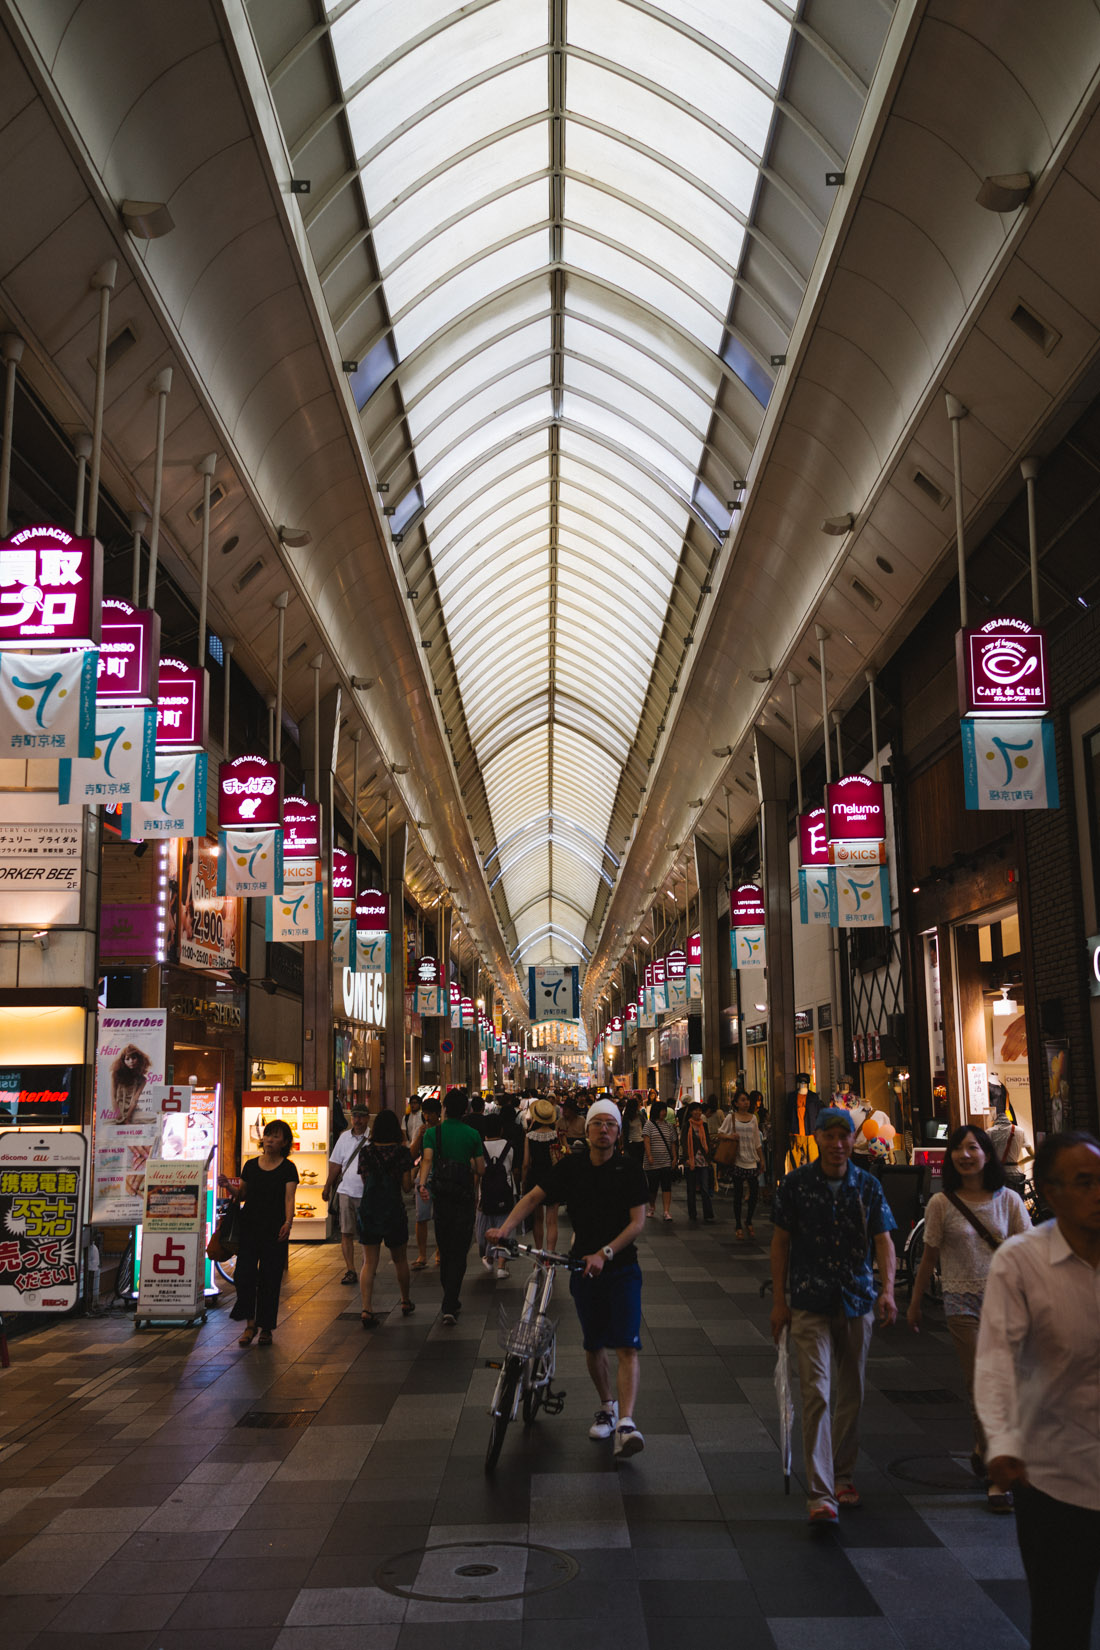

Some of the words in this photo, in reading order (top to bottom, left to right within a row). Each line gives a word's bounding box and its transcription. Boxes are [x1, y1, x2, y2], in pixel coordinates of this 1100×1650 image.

[11, 527, 72, 545] TERAMACHI
[981, 618, 1031, 633] TERAMACHI
[976, 686, 1003, 696] CAFÉ
[1004, 686, 1015, 696] de
[1016, 686, 1042, 696] CRIÉ
[11, 734, 66, 748] 寺町京極
[231, 755, 268, 767] TERAMACHI
[838, 776, 872, 787] TERAMACHI
[85, 783, 130, 795] 寺町京極
[144, 819, 185, 831] 寺町京極
[38, 836, 78, 844] ブライダル
[850, 849, 877, 860] KICS
[46, 868, 78, 879] BEE
[287, 867, 313, 877] KICS
[342, 966, 386, 1028] OMEG
[102, 1017, 164, 1028] Workerbee
[100, 1045, 121, 1056] Hair
[145, 1072, 163, 1084] Spa
[162, 1087, 182, 1112] 占
[100, 1109, 120, 1119] Nail
[149, 1170, 173, 1179] Mari
[175, 1168, 199, 1179] Gold
[1, 1173, 77, 1193] 携帯電話
[12, 1199, 73, 1217] スマート
[26, 1218, 72, 1236] フォン
[0, 1241, 58, 1271] 売って
[153, 1237, 185, 1276] 占
